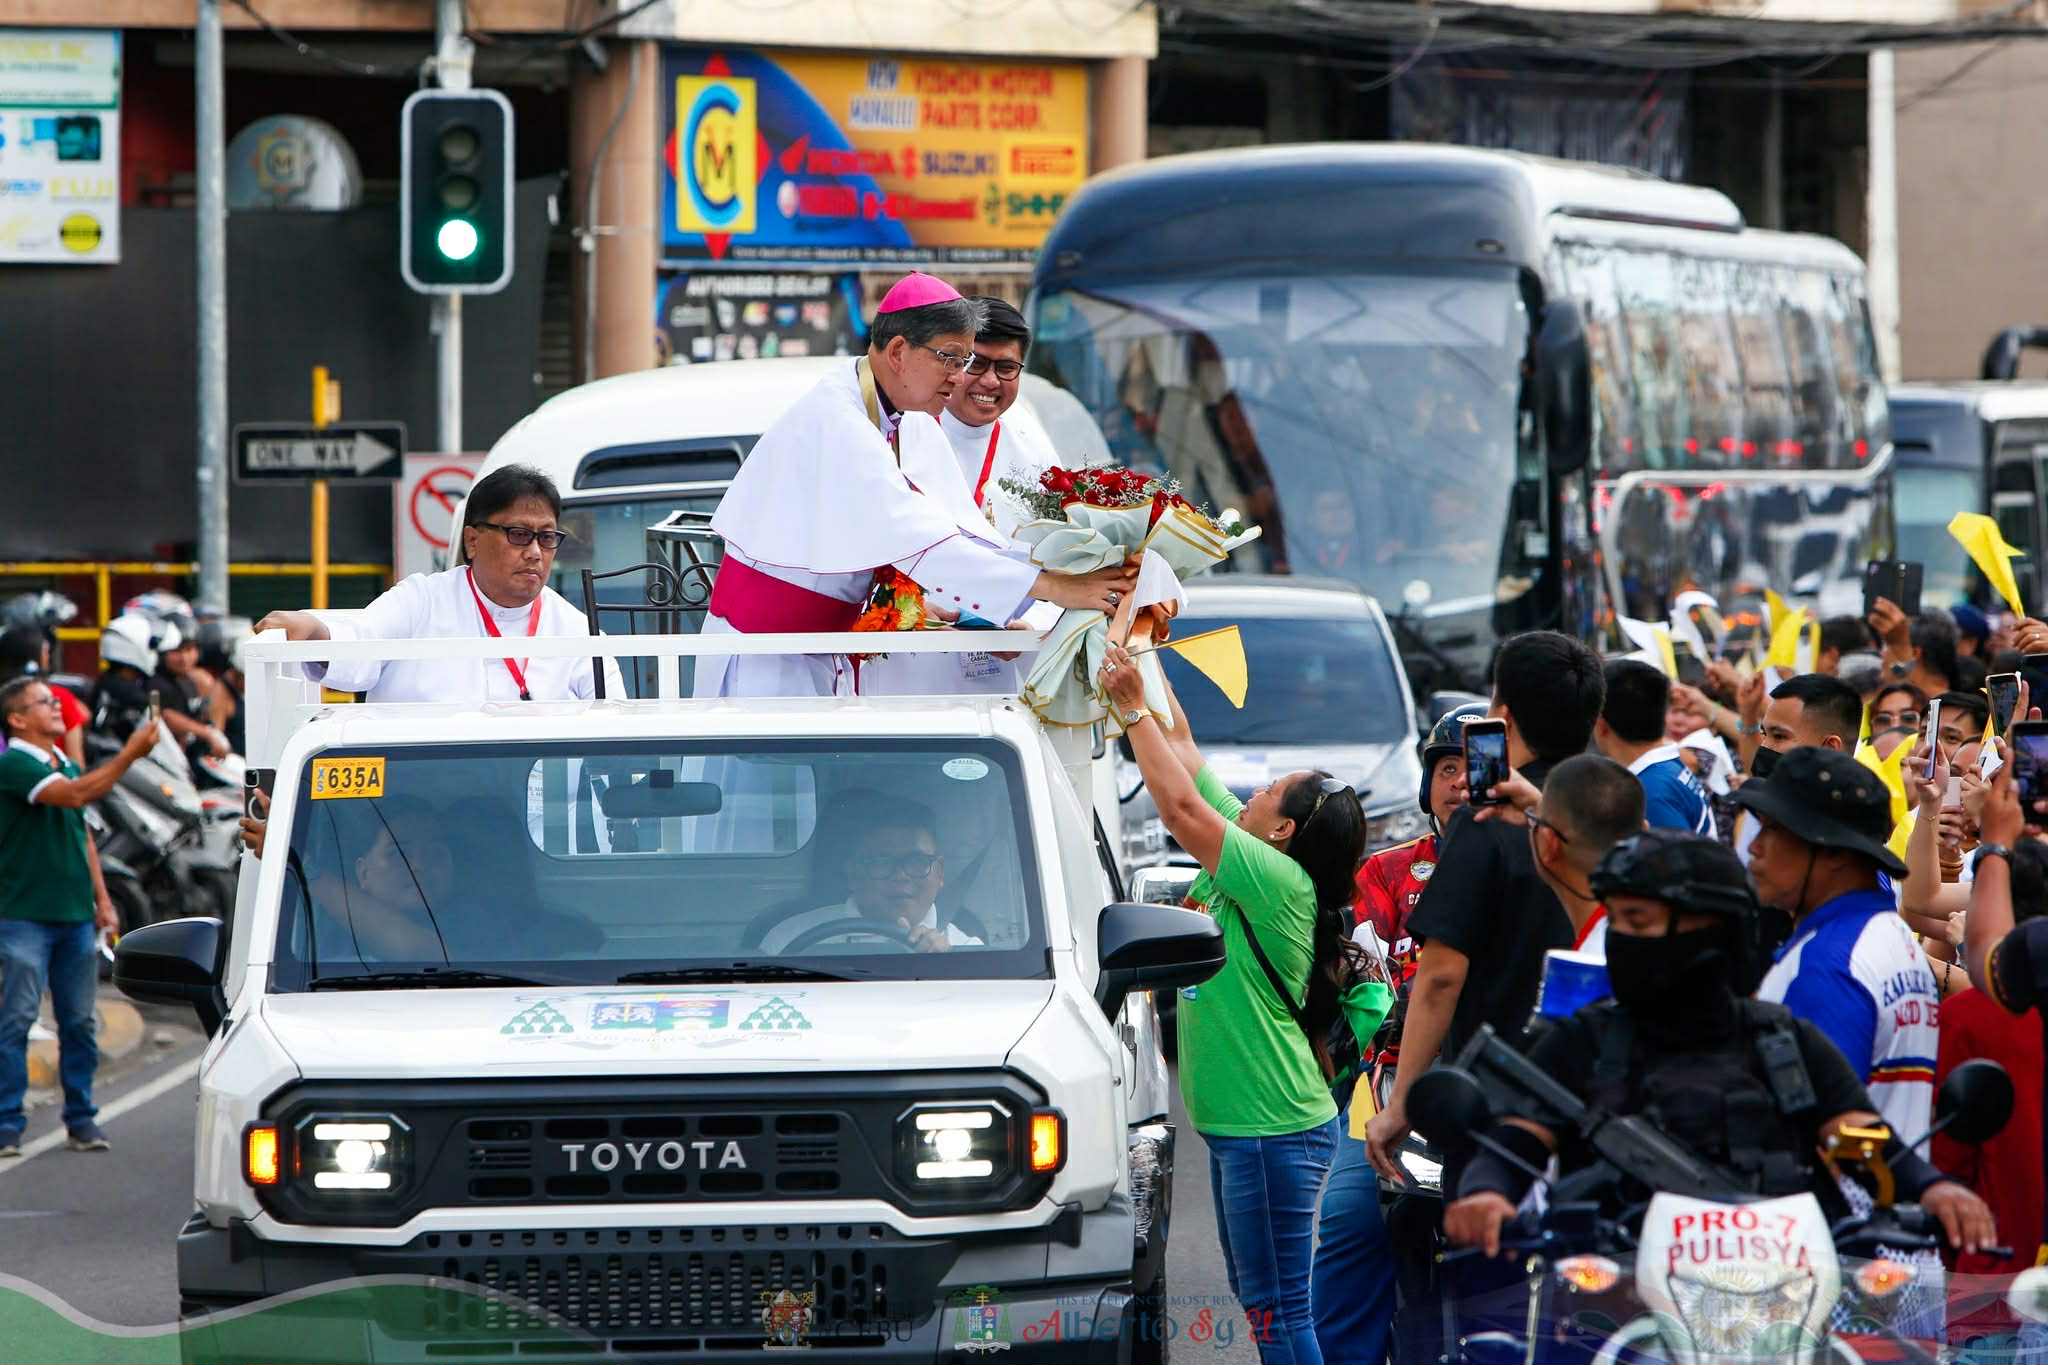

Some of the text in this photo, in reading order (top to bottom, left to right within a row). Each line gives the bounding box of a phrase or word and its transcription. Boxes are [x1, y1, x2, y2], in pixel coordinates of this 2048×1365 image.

[990, 69, 1054, 95] MOTOR
[922, 102, 981, 129] PARTS
[924, 153, 997, 176] SUZUKI
[255, 439, 357, 463] ONE WAY
[328, 766, 380, 789] 635A
[561, 1140, 747, 1172] TOYOTA
[1672, 1205, 1797, 1240] PRO-7
[1667, 1236, 1815, 1279] PULISYA
